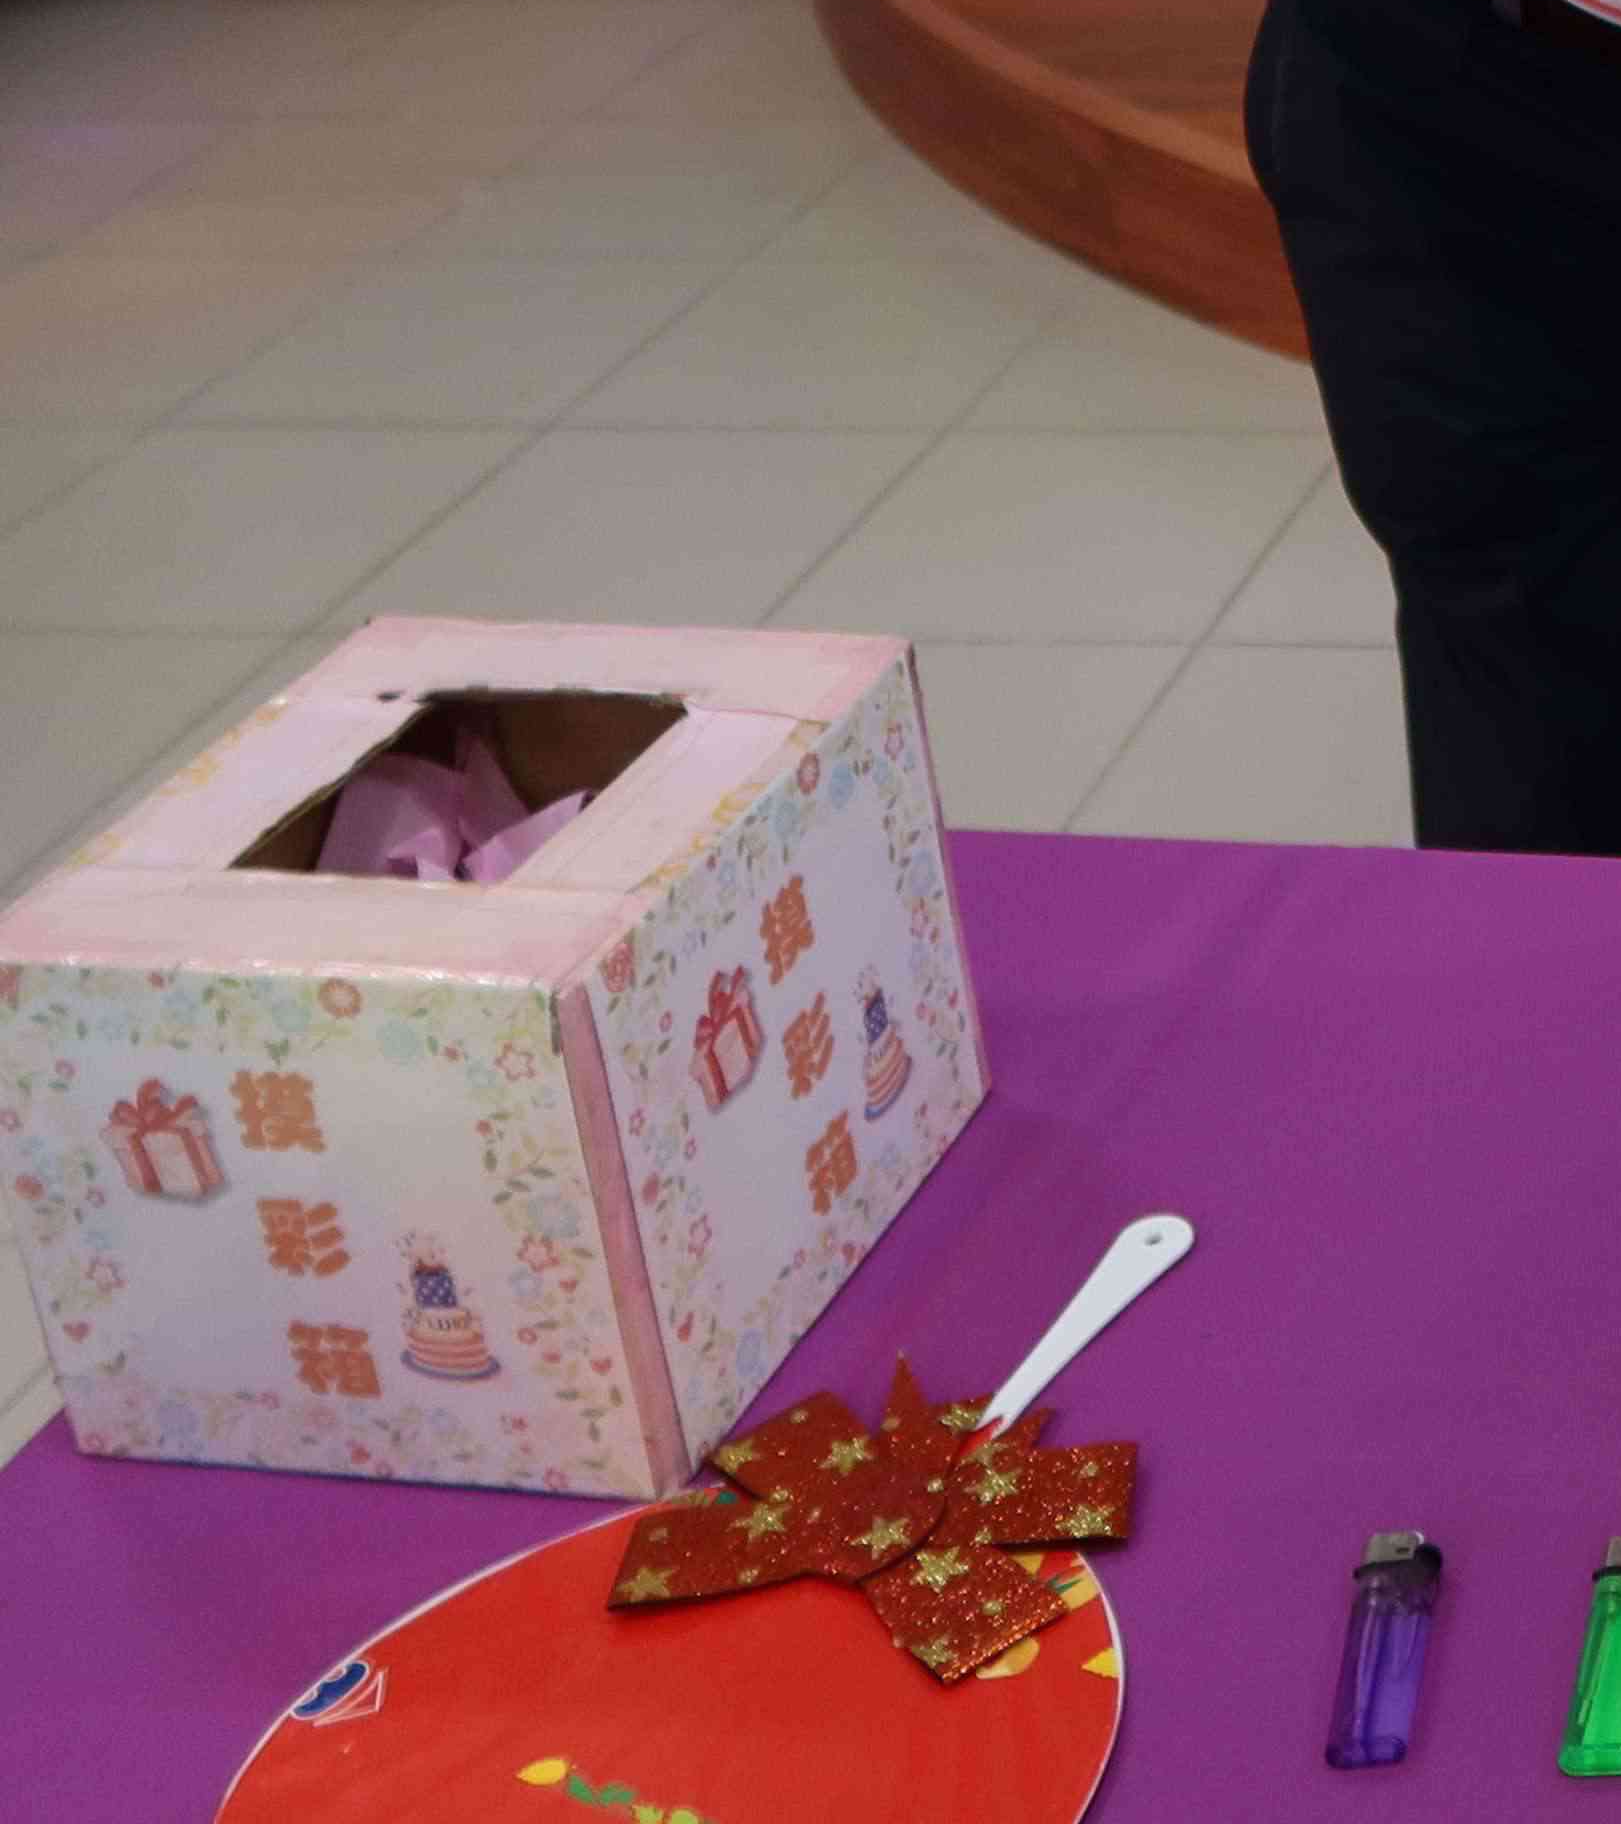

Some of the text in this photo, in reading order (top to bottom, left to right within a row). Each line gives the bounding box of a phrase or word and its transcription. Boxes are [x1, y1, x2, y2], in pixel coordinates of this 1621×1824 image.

[760, 873, 858, 1216] 摸彩箱
[229, 1068, 384, 1401] 摸彩箱
